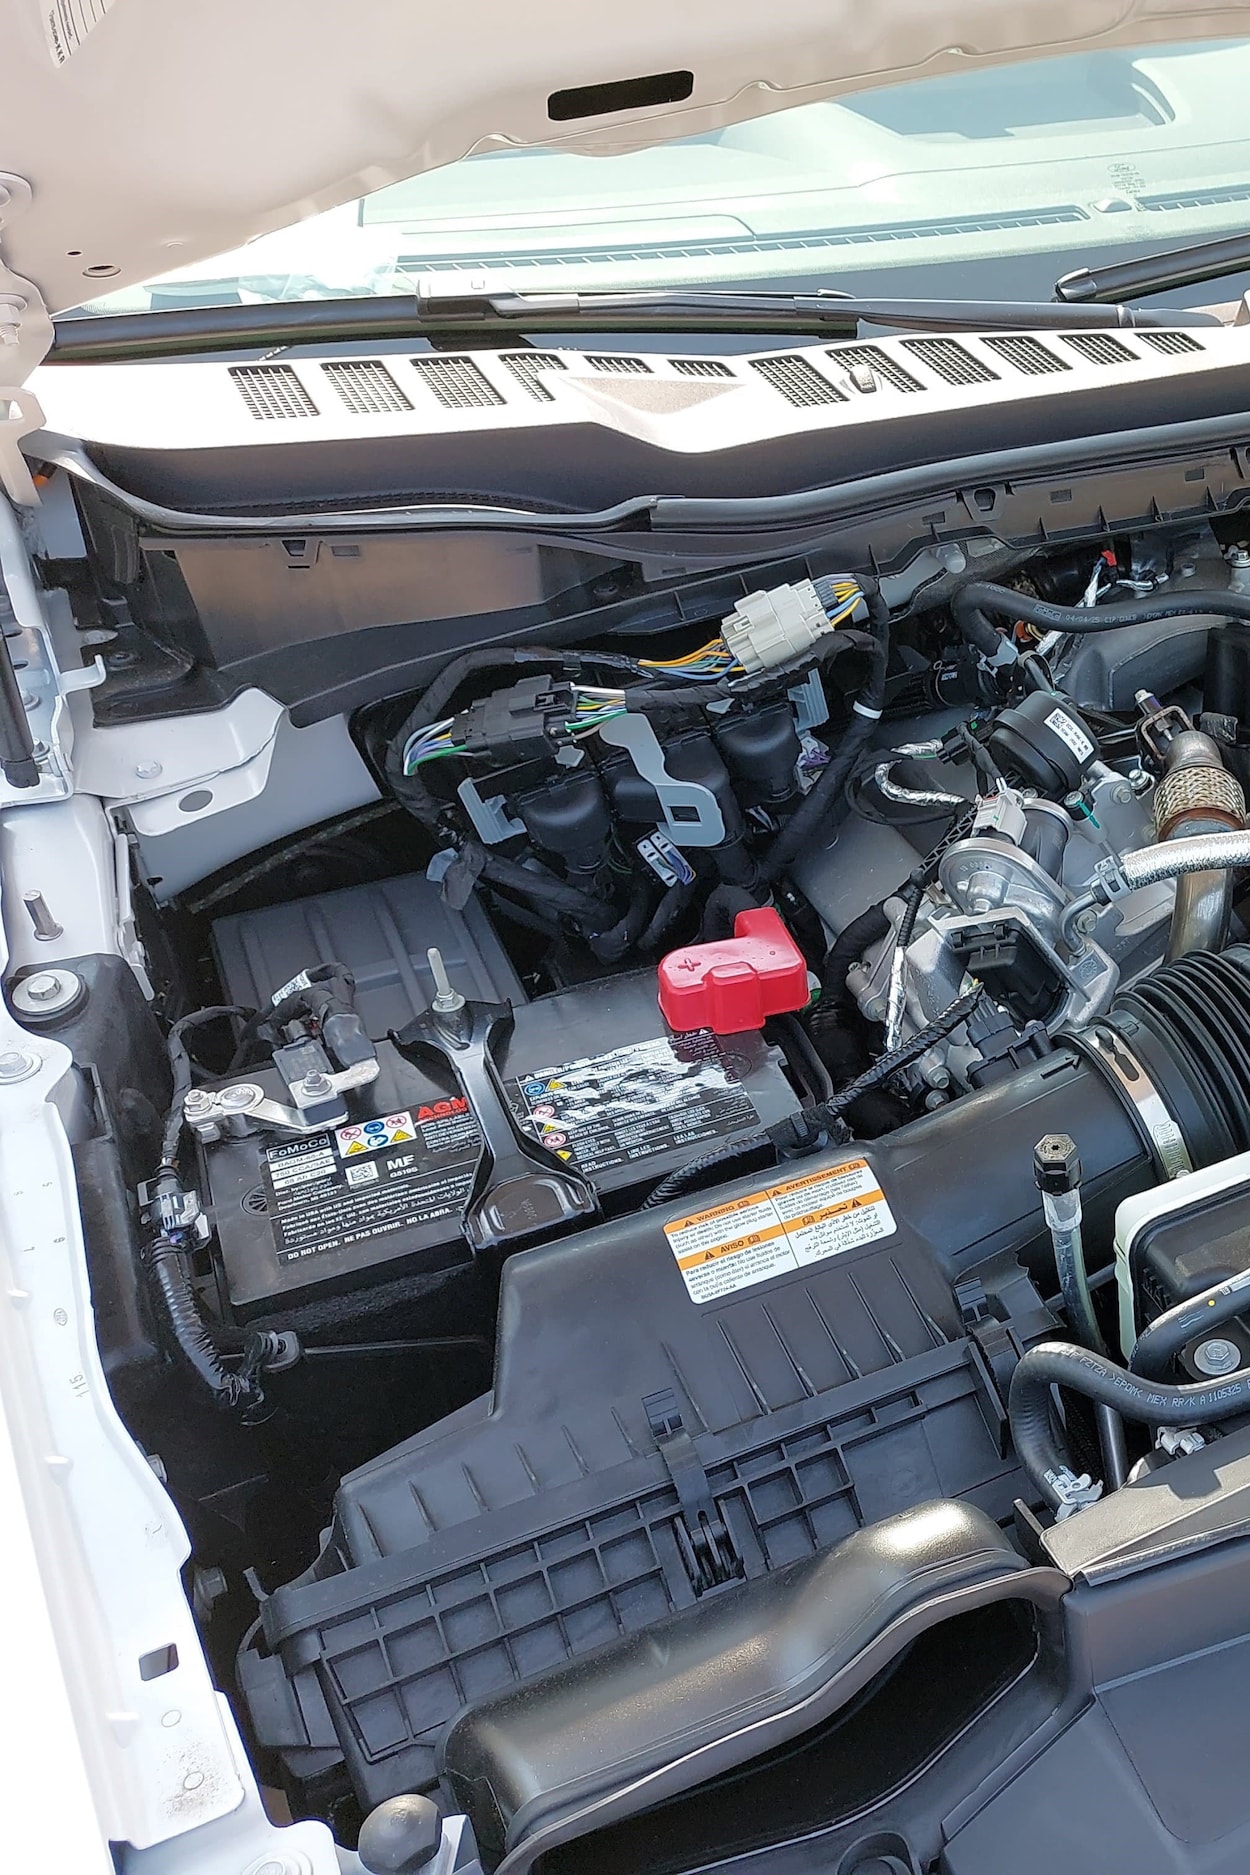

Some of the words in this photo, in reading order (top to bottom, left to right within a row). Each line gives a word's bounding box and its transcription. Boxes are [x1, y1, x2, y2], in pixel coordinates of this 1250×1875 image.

[386, 1154, 414, 1170] MF
[696, 1205, 735, 1221] WARNING
[300, 1246, 316, 1255] NOT
[355, 1230, 370, 1239] PAS
[406, 1216, 418, 1224] NO
[718, 1240, 744, 1252] AVISO
[1146, 1393, 1168, 1407] MEX
